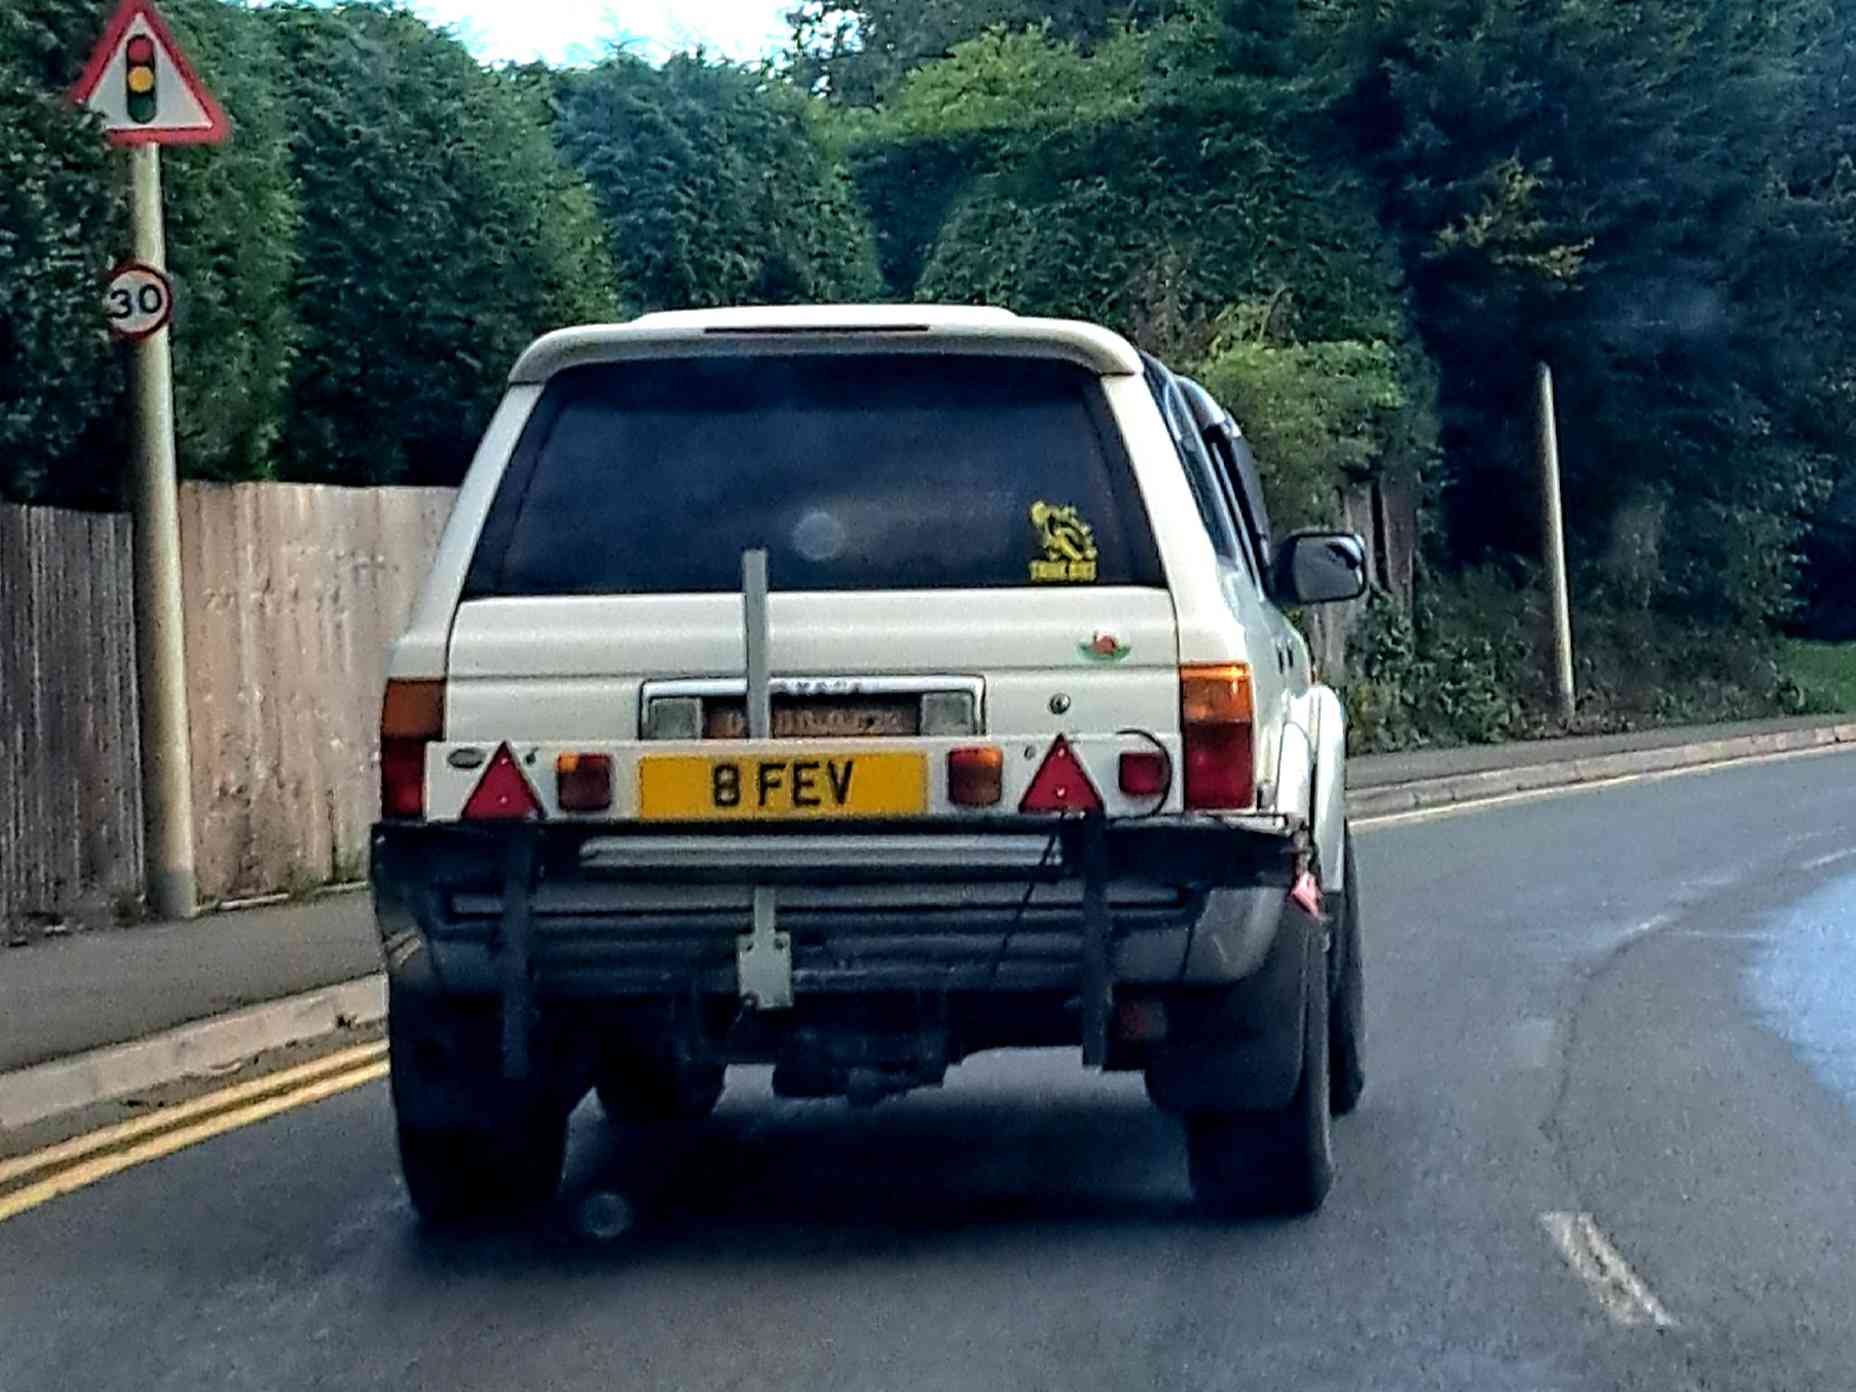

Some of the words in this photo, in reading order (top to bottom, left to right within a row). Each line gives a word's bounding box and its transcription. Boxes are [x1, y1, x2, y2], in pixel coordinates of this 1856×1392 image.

[108, 284, 162, 318] 30
[711, 763, 740, 807] 8
[757, 761, 854, 807] FEV
